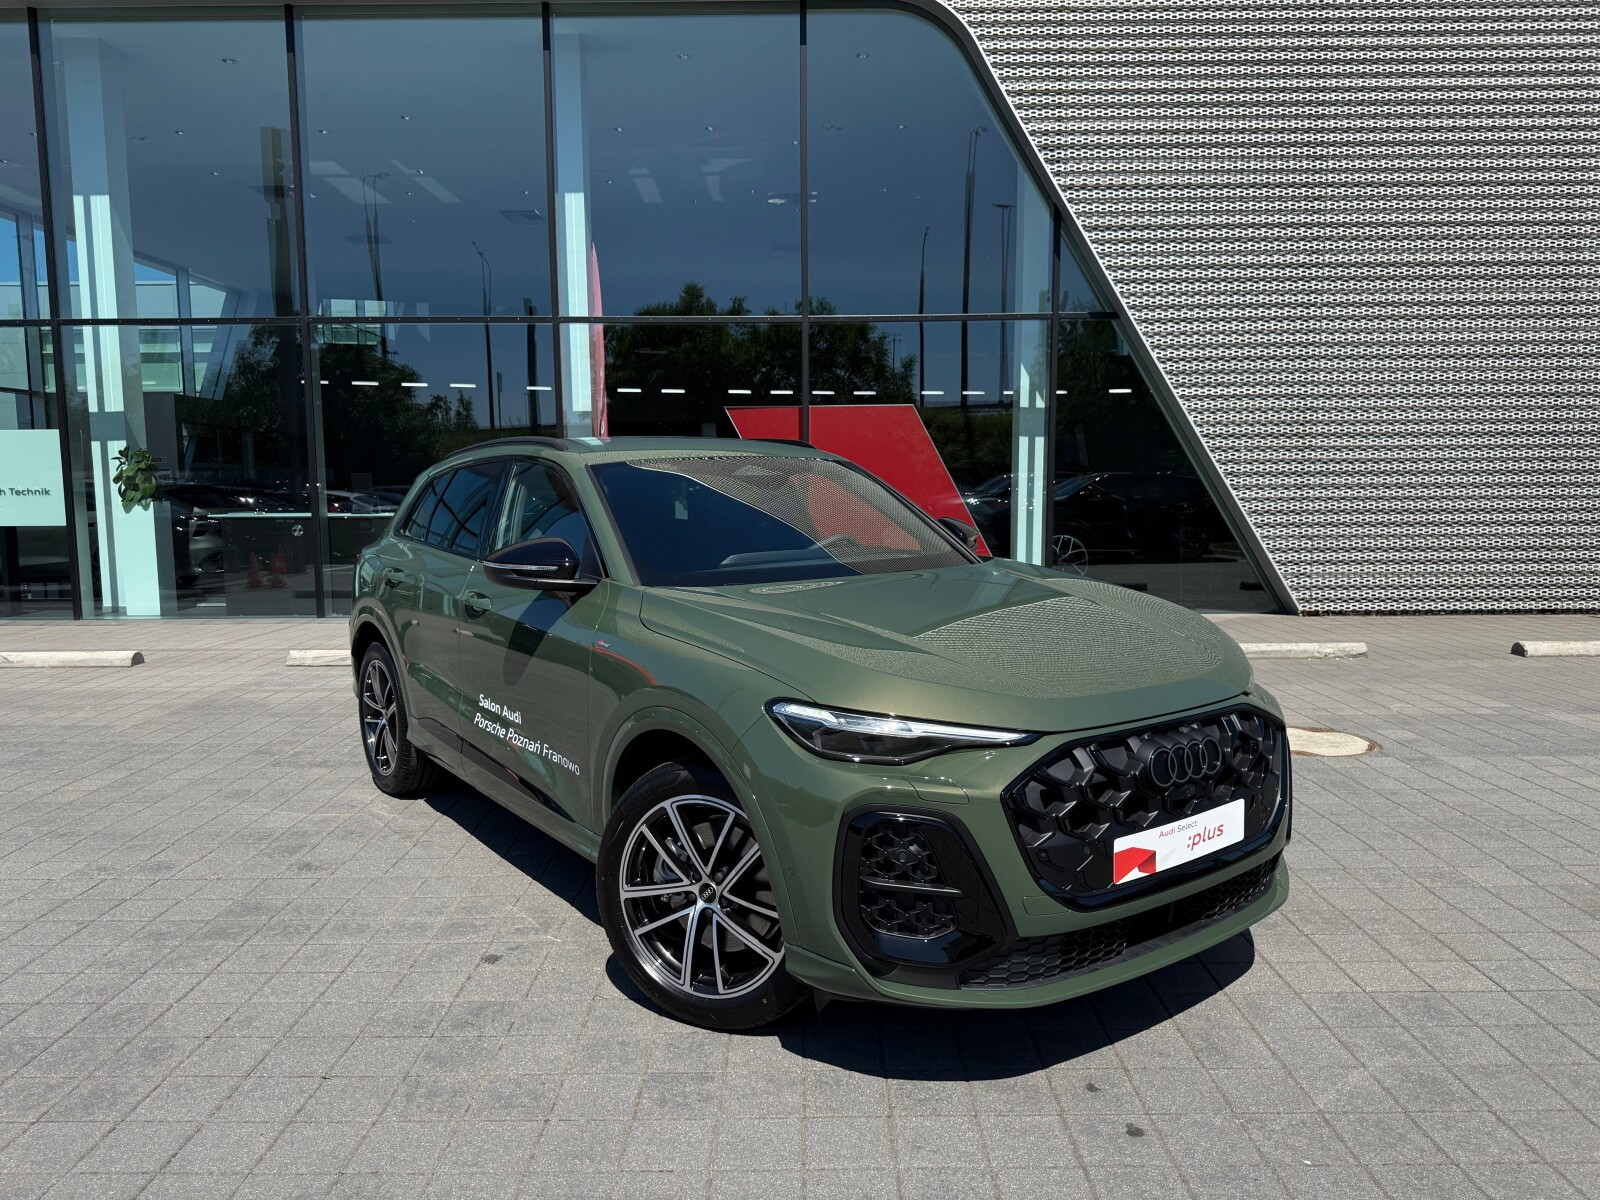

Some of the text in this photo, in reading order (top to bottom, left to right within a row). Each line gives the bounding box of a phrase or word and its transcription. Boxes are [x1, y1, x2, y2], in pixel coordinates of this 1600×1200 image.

[8, 487, 51, 496] Technik
[478, 693, 522, 725] Salon Audi
[473, 712, 580, 775] Porsche Poznań Franowo
[1158, 820, 1198, 839] Audi Select
